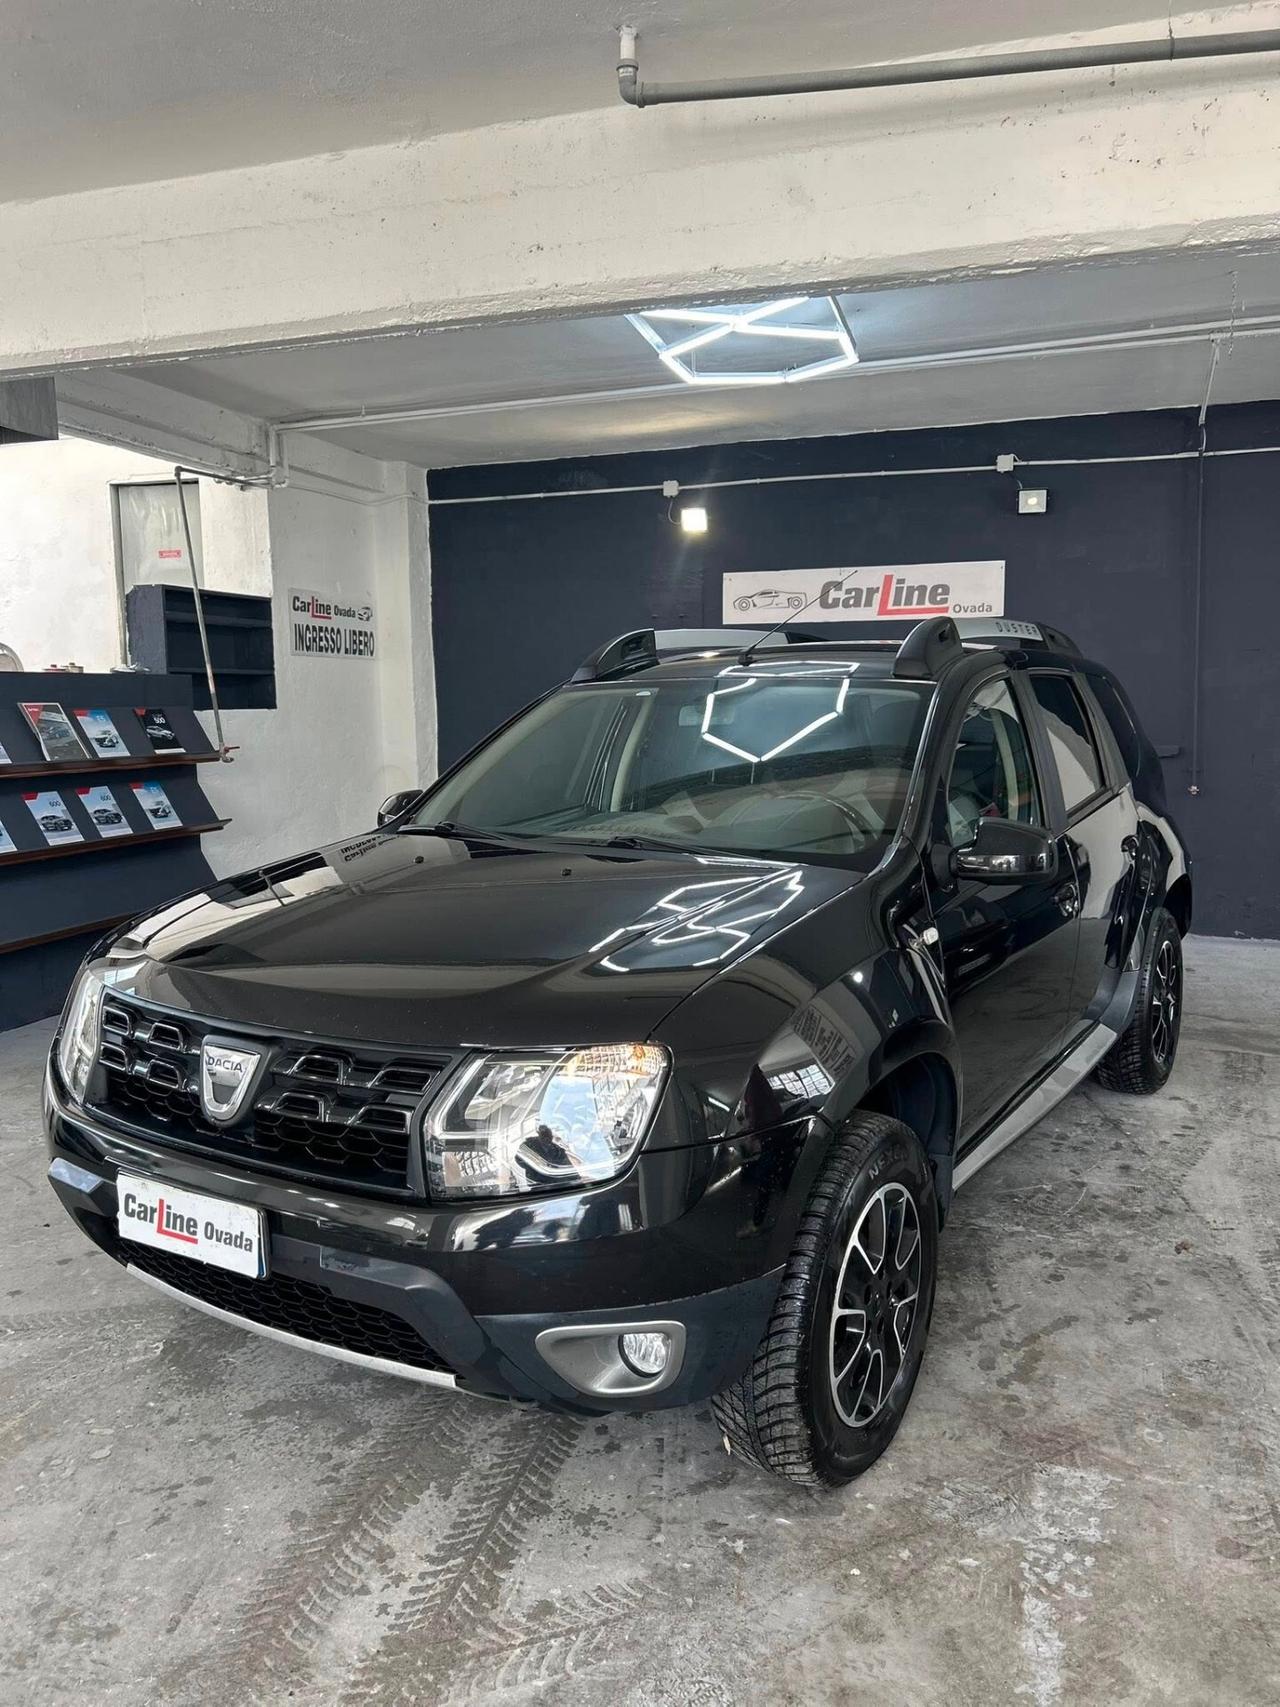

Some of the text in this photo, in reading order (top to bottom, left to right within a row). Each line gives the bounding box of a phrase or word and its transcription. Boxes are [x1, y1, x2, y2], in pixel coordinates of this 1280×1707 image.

[292, 595, 356, 620] CarLine Ovada
[819, 574, 993, 616] CarLine Ovada
[294, 624, 375, 657] INGRESSO LIBERO
[995, 622, 1038, 636] DUSTER
[207, 1056, 243, 1073] DACIA
[124, 1193, 253, 1253] CarLine Ovada
